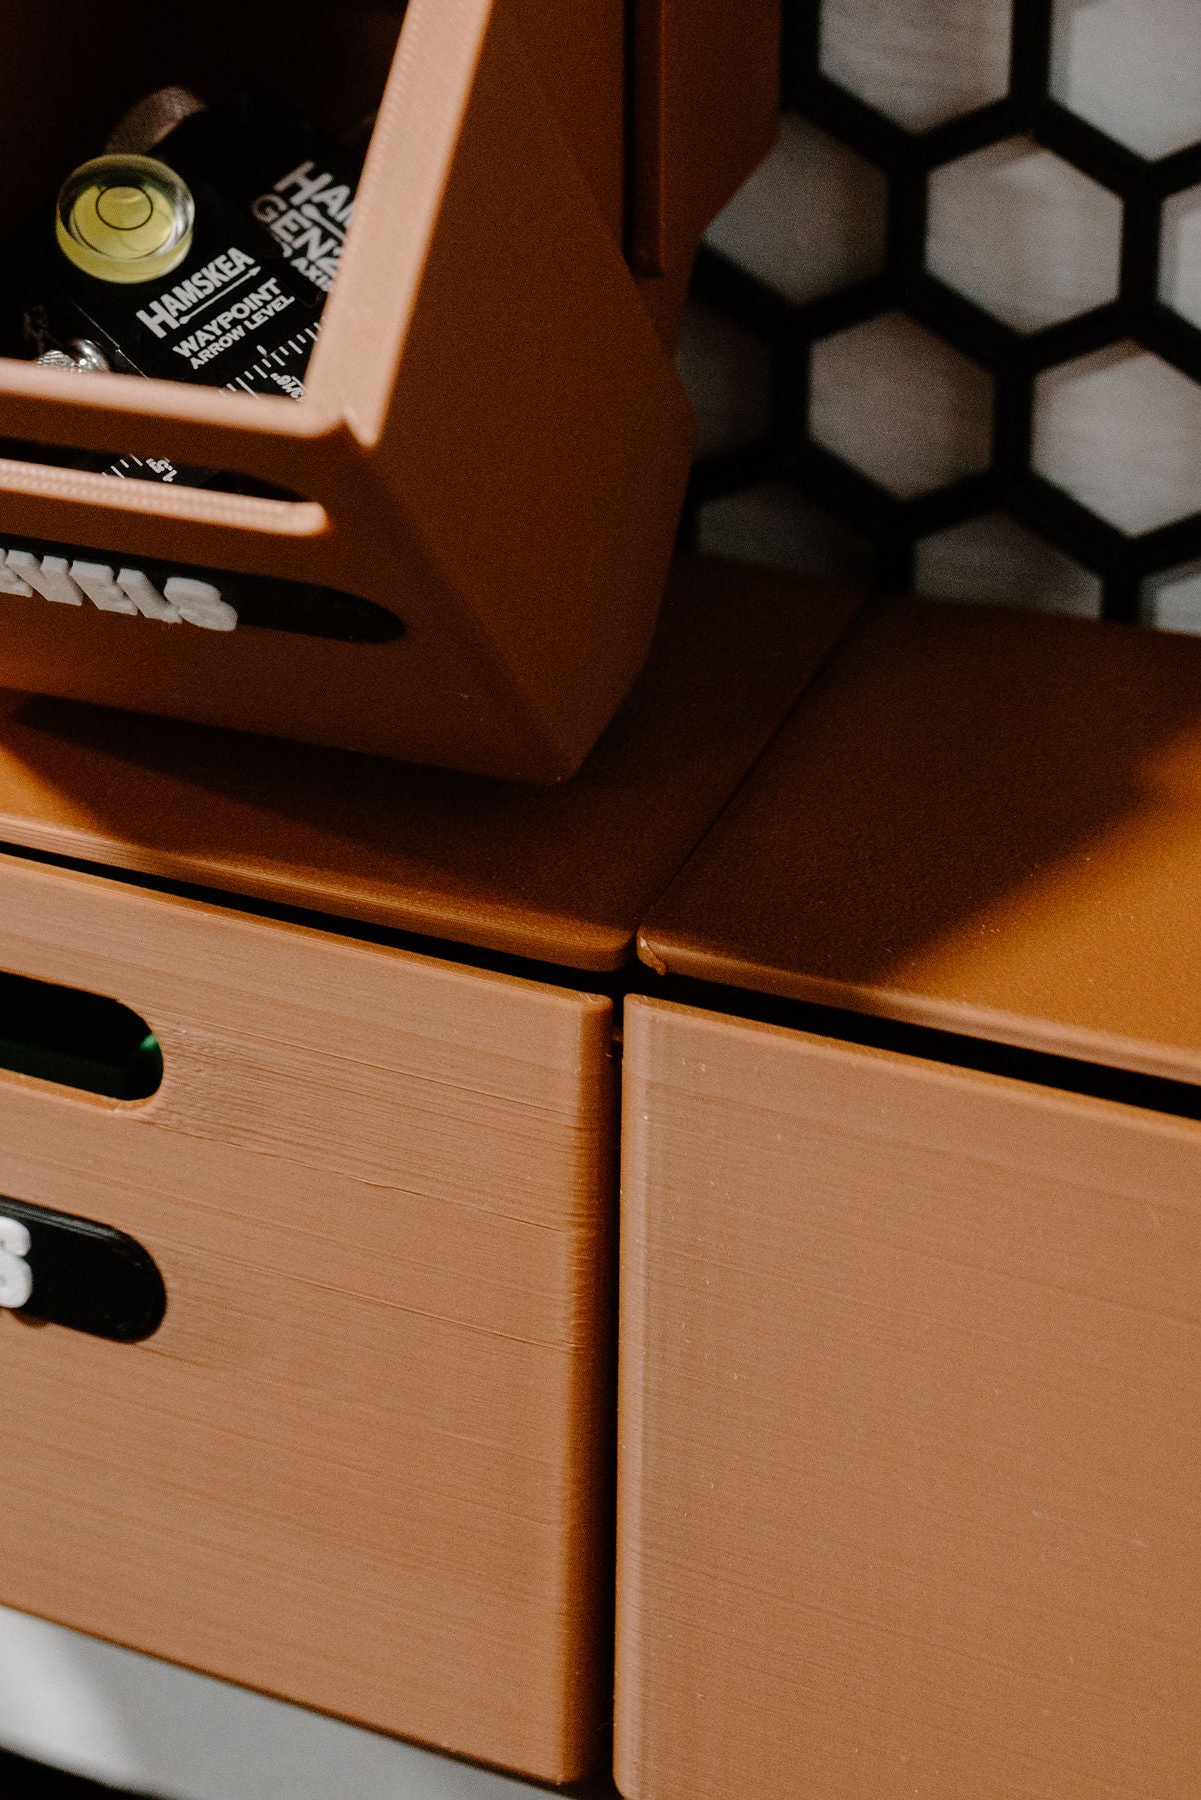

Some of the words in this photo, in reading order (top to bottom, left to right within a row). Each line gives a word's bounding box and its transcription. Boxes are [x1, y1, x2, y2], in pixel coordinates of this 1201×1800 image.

[136, 247, 255, 338] HAMSKEA
[173, 278, 281, 358] WAYPOINT
[189, 325, 246, 370] ARROW
[244, 295, 295, 330] LEVEL
